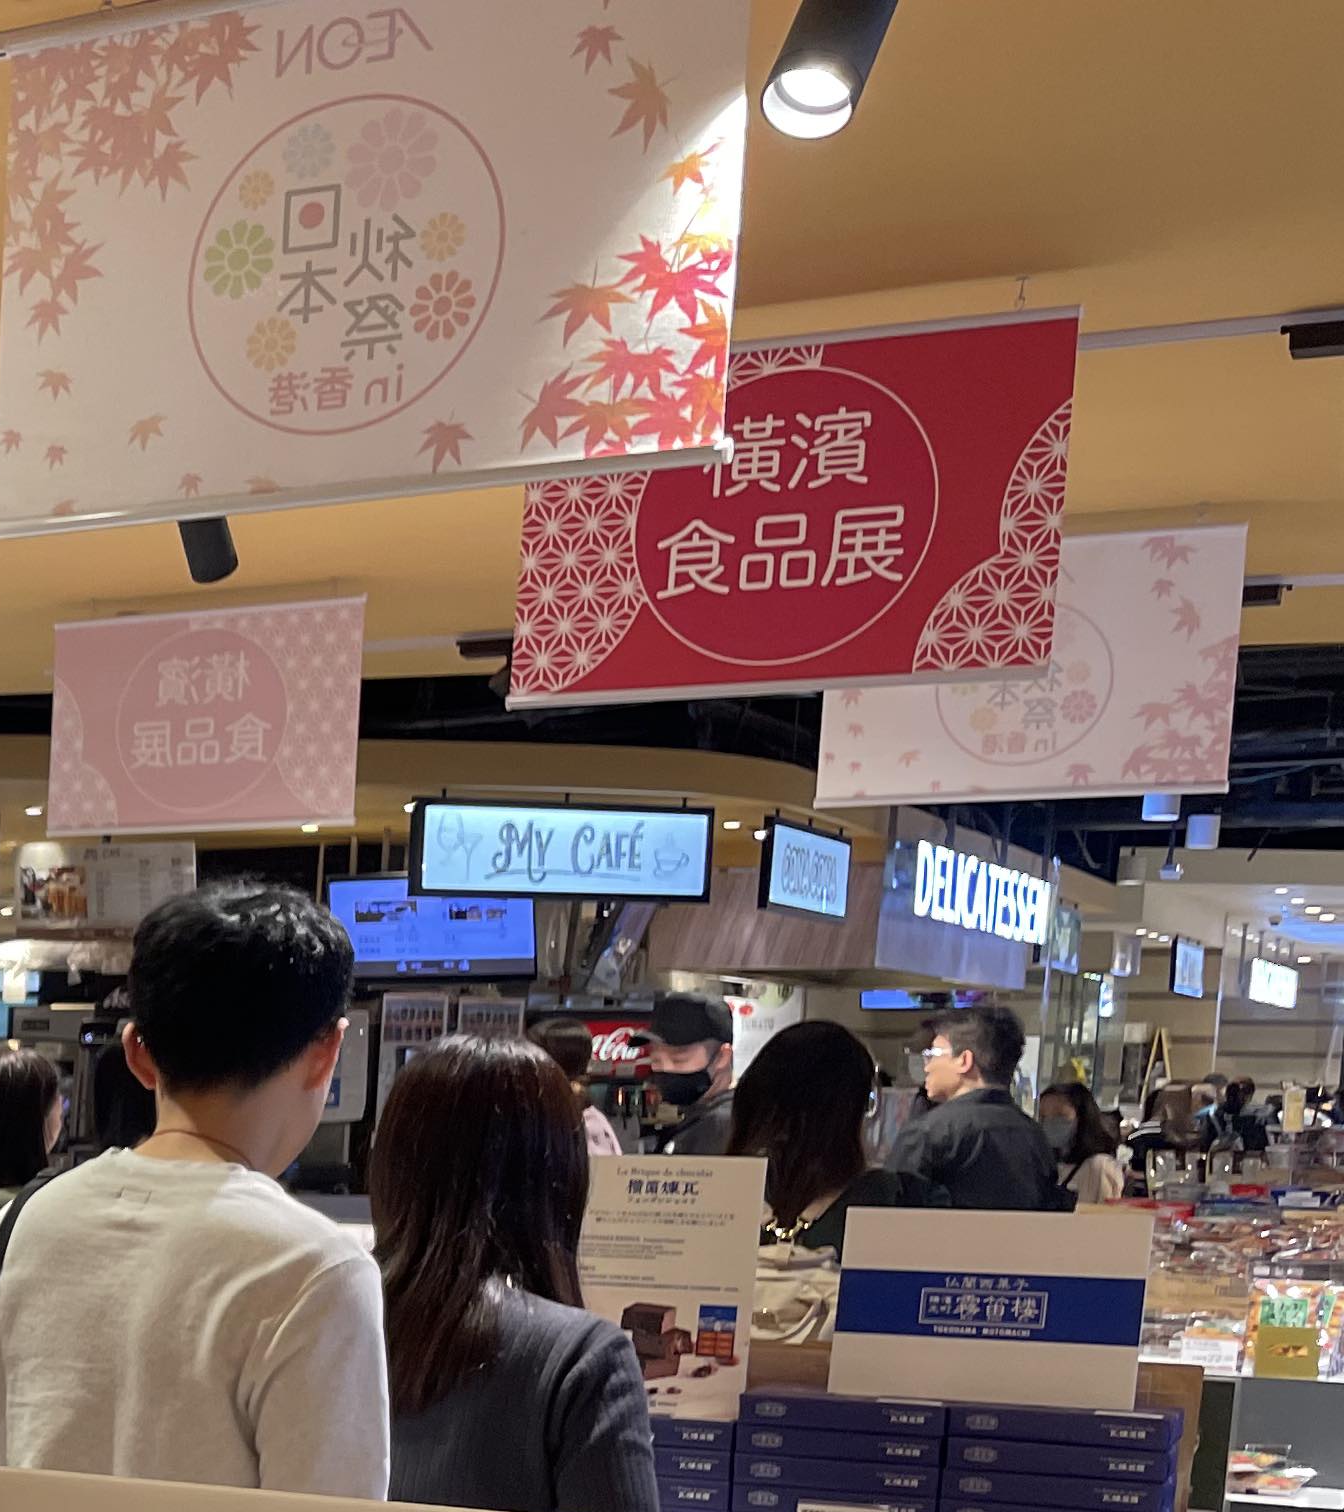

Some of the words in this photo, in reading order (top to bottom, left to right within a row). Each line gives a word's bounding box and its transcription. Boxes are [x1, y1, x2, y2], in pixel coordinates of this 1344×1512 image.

[656, 504, 905, 600] 食品展
[914, 840, 1051, 945] DELICATESSEN
